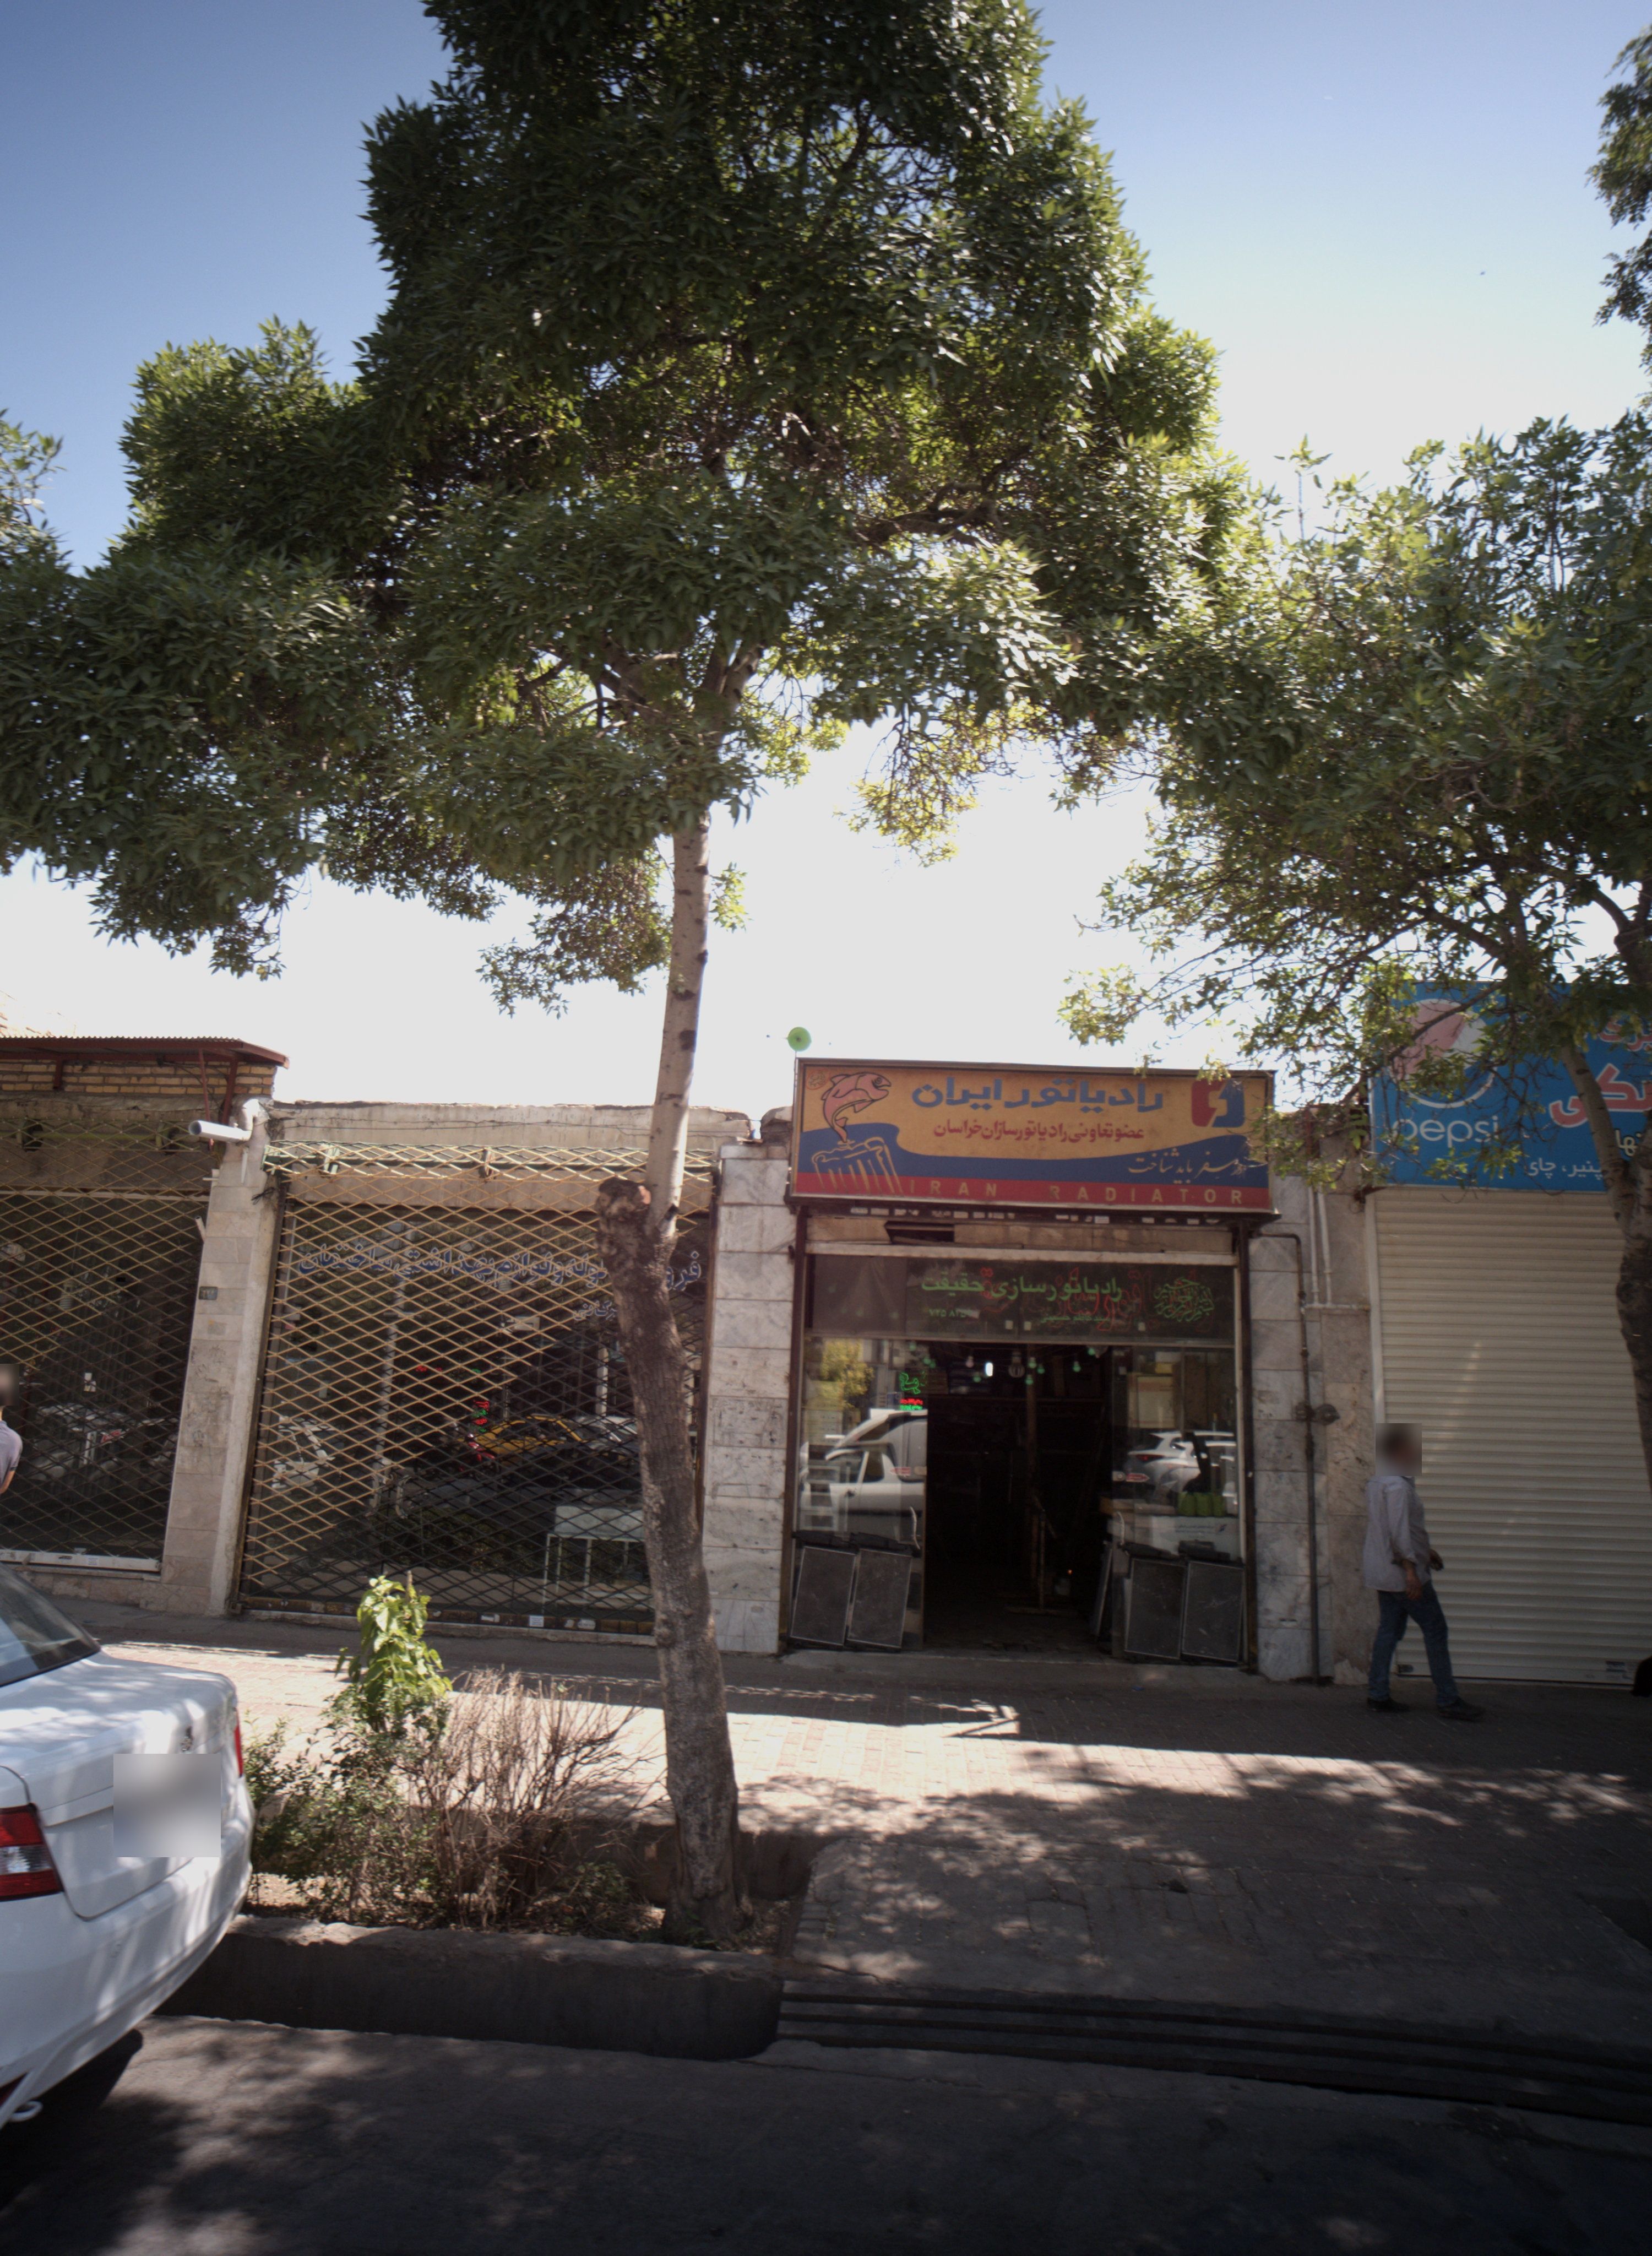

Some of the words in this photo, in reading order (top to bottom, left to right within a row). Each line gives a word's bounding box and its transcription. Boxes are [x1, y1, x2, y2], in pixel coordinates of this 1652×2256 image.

[912, 1076, 1003, 1110] ایران
[1004, 1078, 1164, 1113] رادیاتور
[933, 1119, 982, 1139] خراسان
[1068, 1122, 1113, 1143] تعاونی
[1114, 1124, 1145, 1142] عضو
[1128, 1147, 1180, 1174] شناخت
[1173, 1158, 1193, 1184] باید
[1528, 1157, 1556, 1179] چای
[909, 1179, 997, 1197] IRAN
[1049, 1185, 1243, 1205] RADIATOR
[921, 1271, 985, 1297] حقیقت
